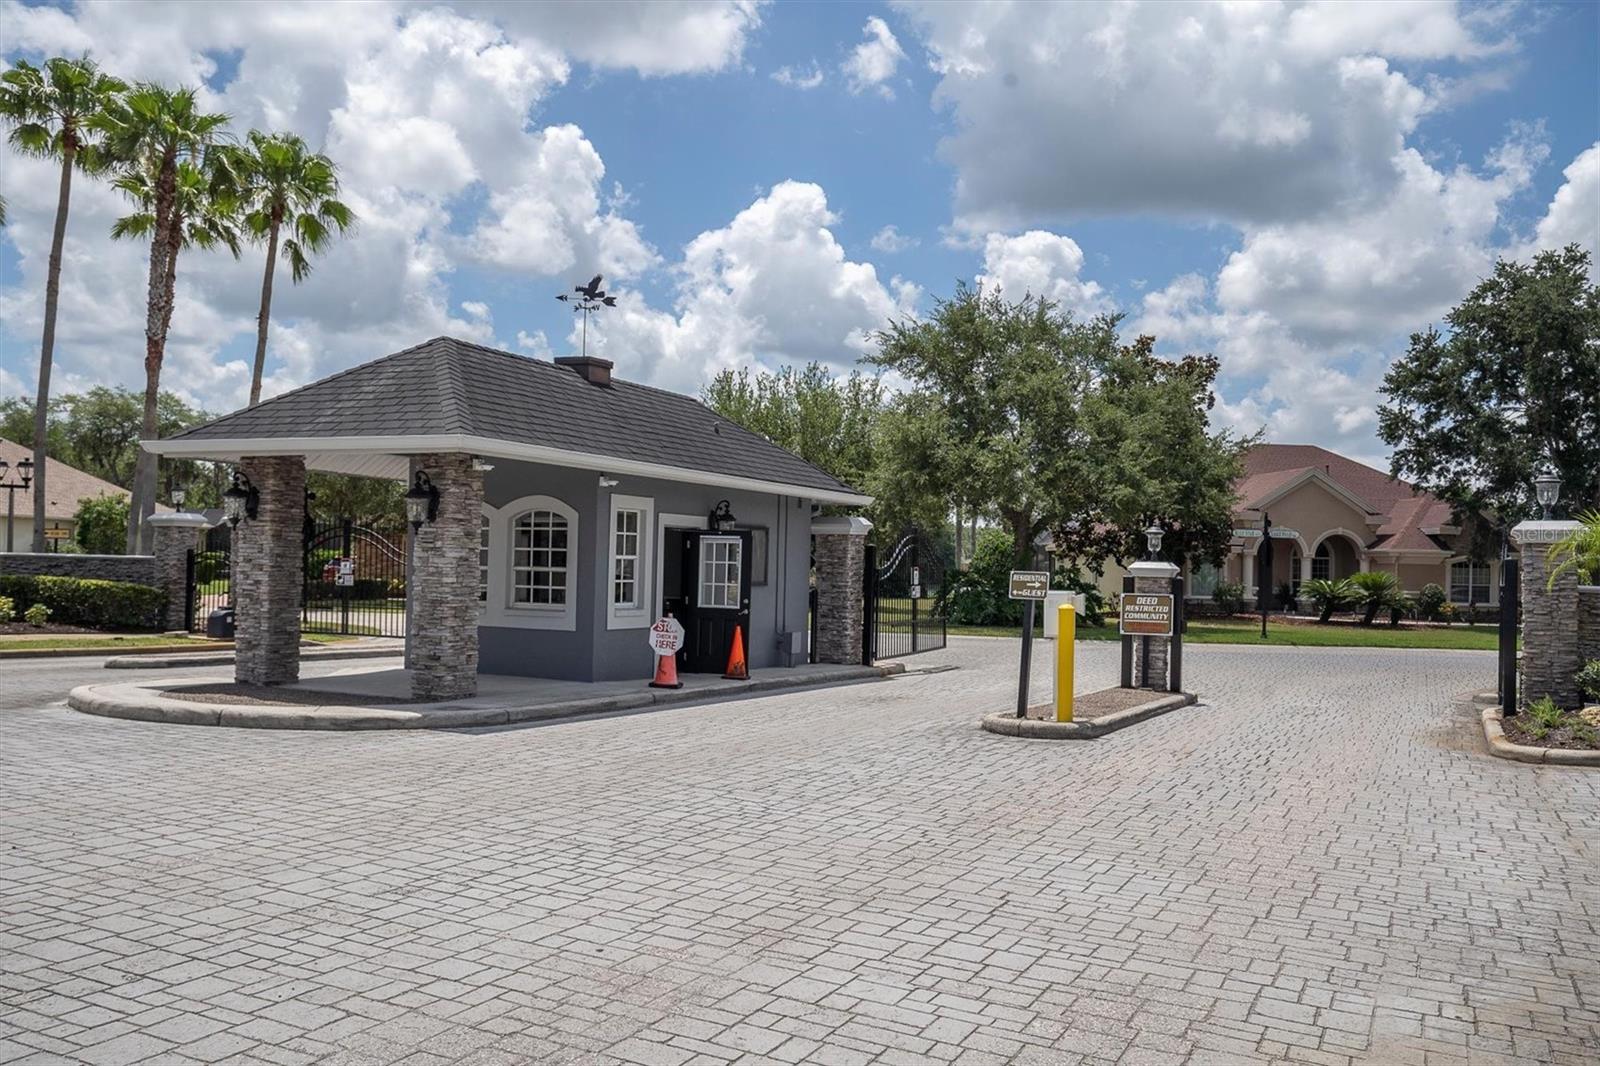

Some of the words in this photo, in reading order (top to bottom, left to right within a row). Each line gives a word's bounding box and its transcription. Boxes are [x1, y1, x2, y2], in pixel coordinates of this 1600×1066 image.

[1013, 574, 1046, 582] RESIDENTIAL
[1022, 589, 1046, 597] GUEST
[1136, 596, 1158, 605] DEED
[1125, 605, 1169, 613] RESTRICTED
[1124, 612, 1169, 620] COMMUNITY
[657, 622, 677, 632] STO
[655, 640, 677, 651] HERE
